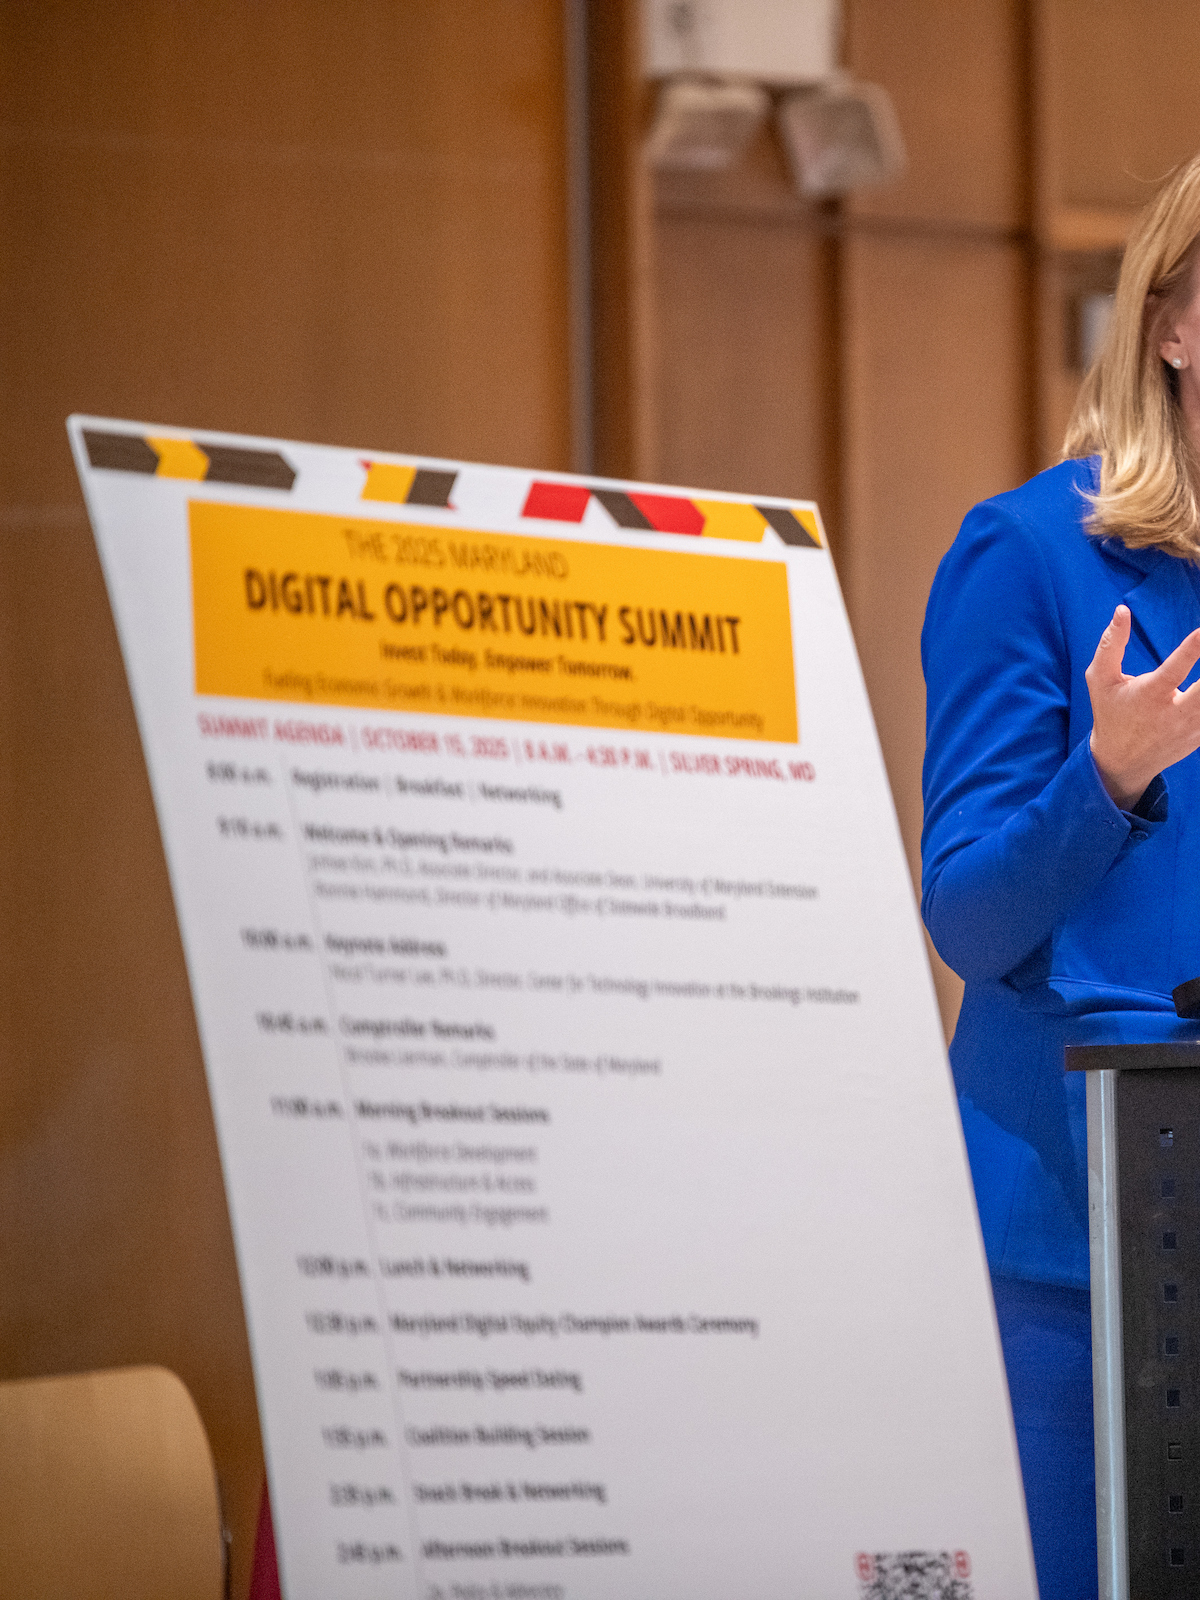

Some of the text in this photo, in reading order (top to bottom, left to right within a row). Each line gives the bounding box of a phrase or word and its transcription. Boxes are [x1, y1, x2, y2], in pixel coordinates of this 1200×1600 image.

[343, 529, 570, 581] THE 2025 MARYLAND
[243, 566, 742, 657] DIGITAL OPPORTUNITY SUMMIT
[199, 715, 270, 743] SUMMIT
[274, 721, 345, 749] AGENDA
[362, 727, 439, 756] OCTOBER
[443, 735, 467, 760] 15,
[471, 736, 510, 762] 2025
[670, 751, 722, 778] SILVER
[725, 756, 787, 785] SPRING,
[789, 761, 816, 784] MD
